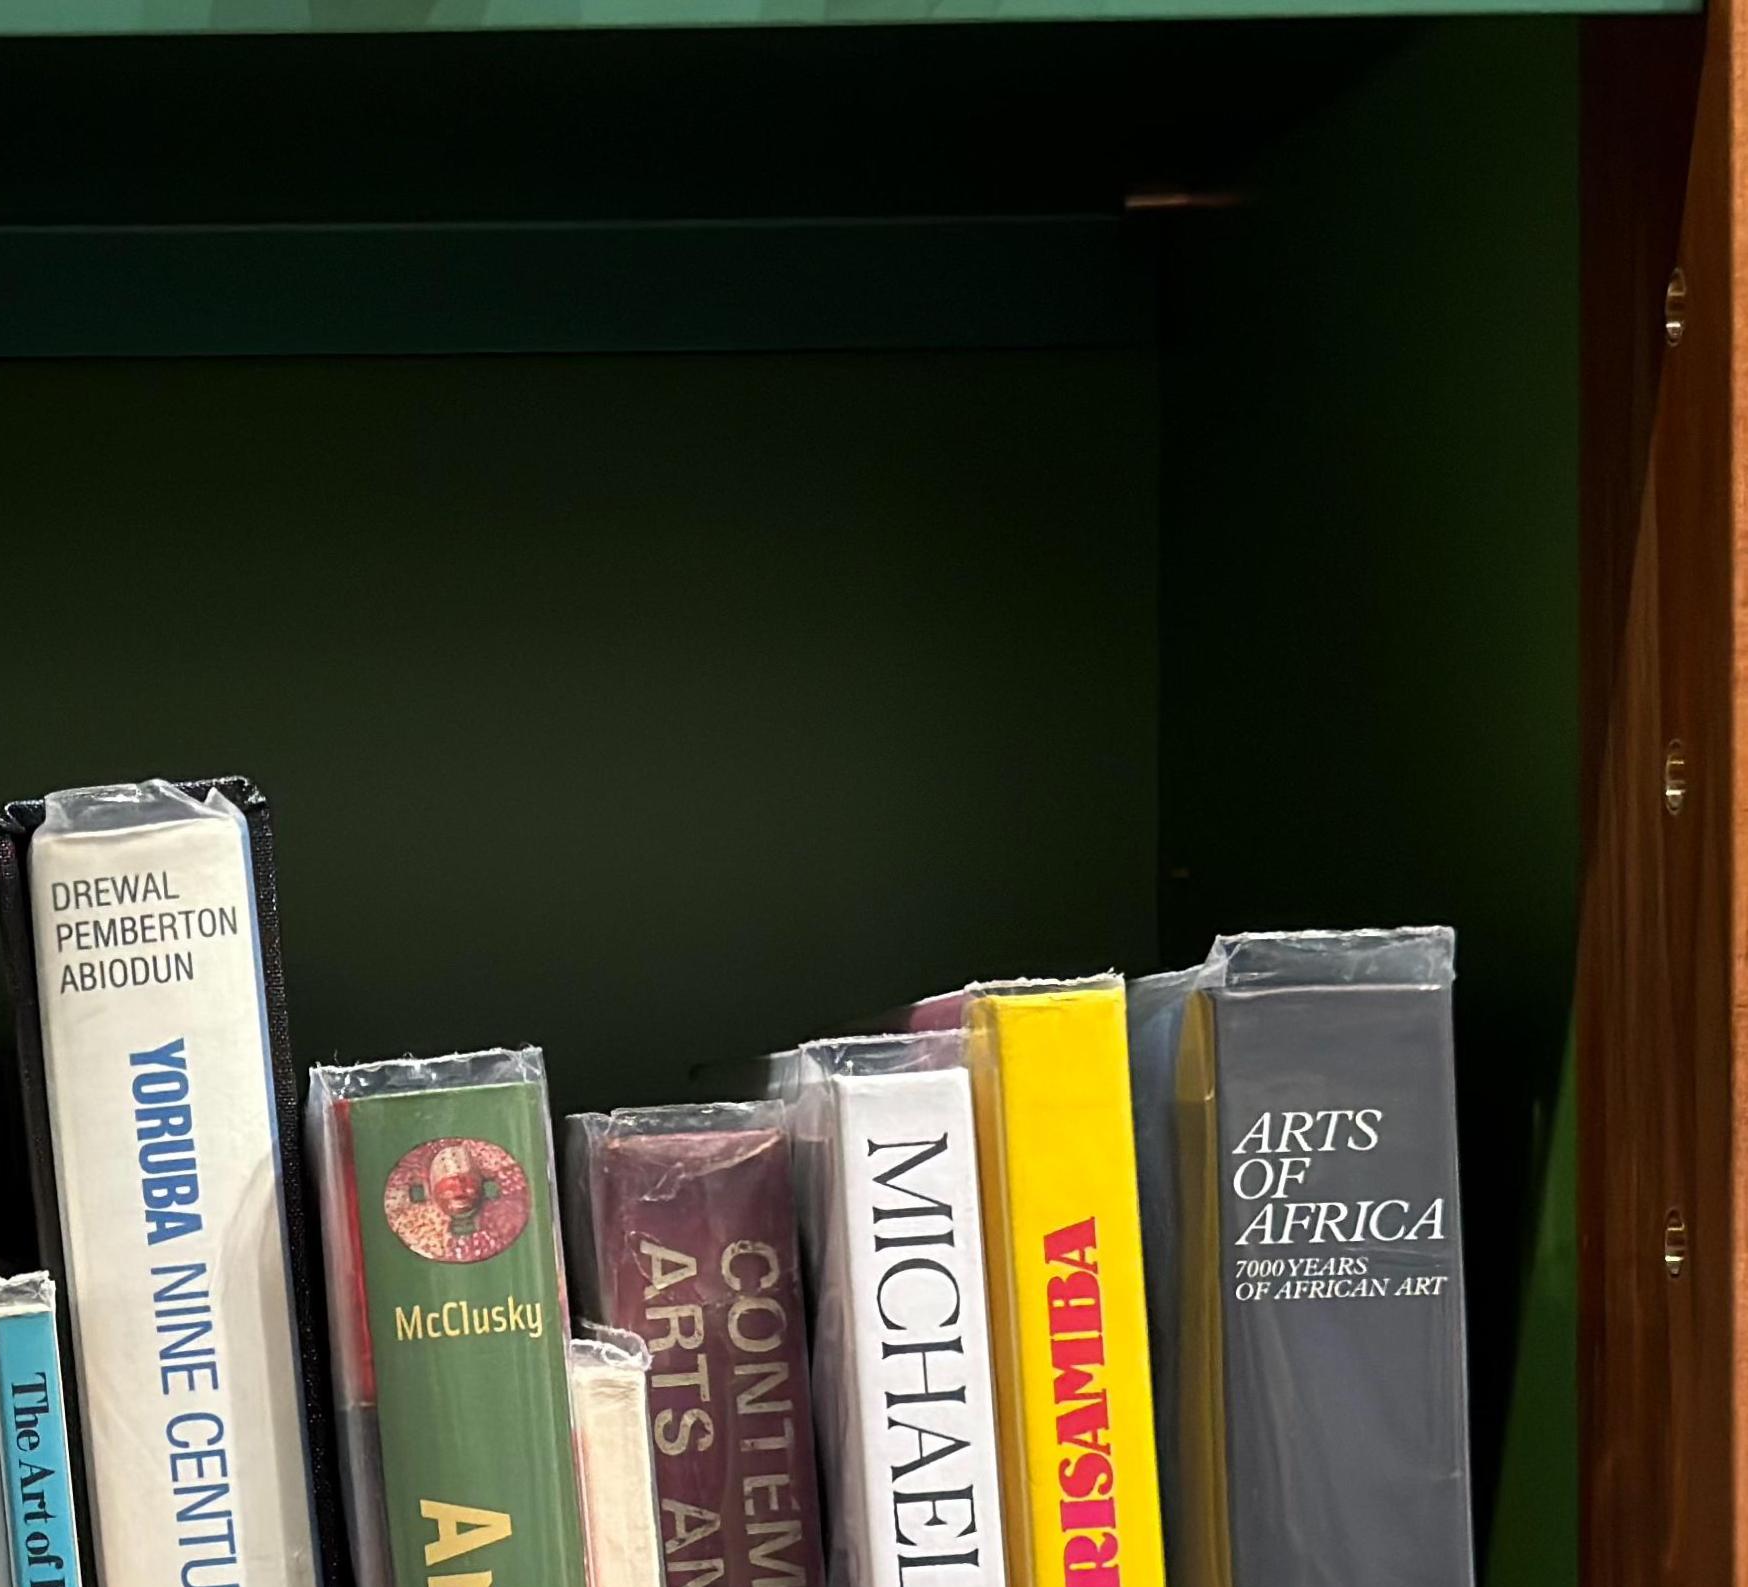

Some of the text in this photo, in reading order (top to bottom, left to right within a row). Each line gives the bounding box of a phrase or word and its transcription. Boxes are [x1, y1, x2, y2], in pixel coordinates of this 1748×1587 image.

[50, 870, 180, 913] DREWAL
[56, 906, 239, 954] PEMBERTON
[59, 951, 195, 996] ABIODUN
[128, 1037, 204, 1247] YORUBA
[1232, 1108, 1384, 1154] ARTS
[1232, 1156, 1311, 1201] OF
[1234, 1198, 1446, 1246] AFRICA
[1234, 1275, 1449, 1301] OF AFRICAN ART
[1235, 1256, 1370, 1279] 7000 YEARS
[150, 1261, 221, 1396] NINE
[394, 1297, 544, 1342] McClusky
[638, 1238, 716, 1458] ARTS
[10, 1371, 50, 1454] The
[18, 1456, 56, 1528] Art
[25, 1531, 64, 1574] of
